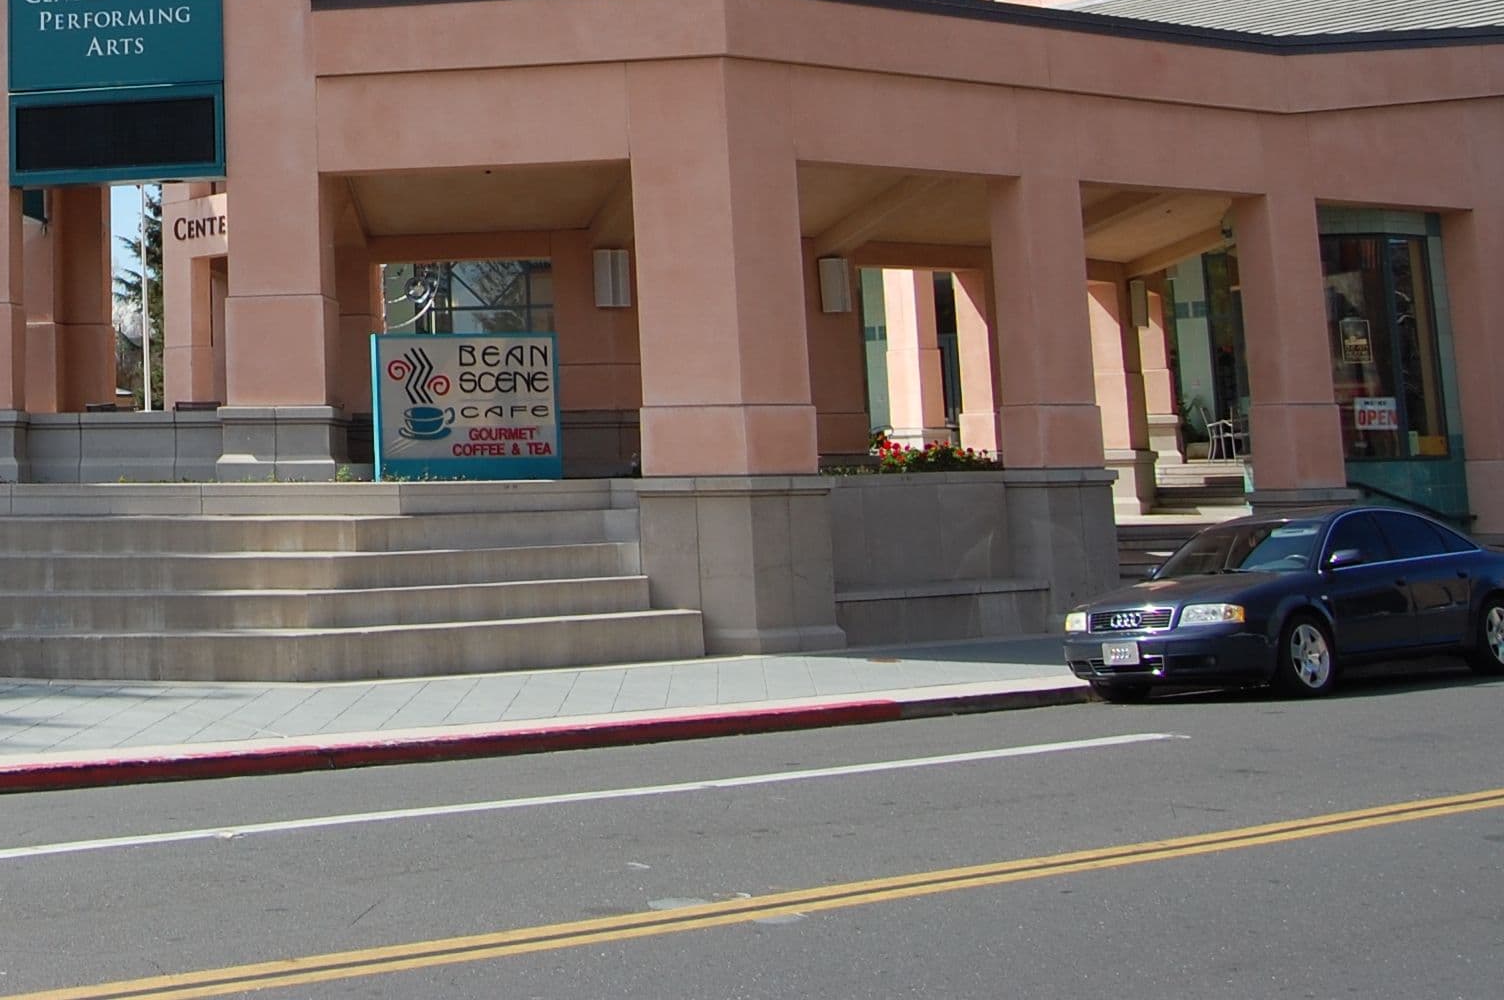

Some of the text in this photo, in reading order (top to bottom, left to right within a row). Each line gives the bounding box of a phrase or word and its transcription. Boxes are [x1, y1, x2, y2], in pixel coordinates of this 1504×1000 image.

[39, 6, 191, 31] PERFORMING
[86, 37, 144, 57] ARTS
[458, 344, 549, 368] BEAN
[459, 371, 550, 394] SCENE
[460, 404, 550, 419] CAFE
[1359, 408, 1400, 427] OPEN
[468, 427, 536, 442] GOURMET
[452, 442, 552, 457] COFFEE & TEA
